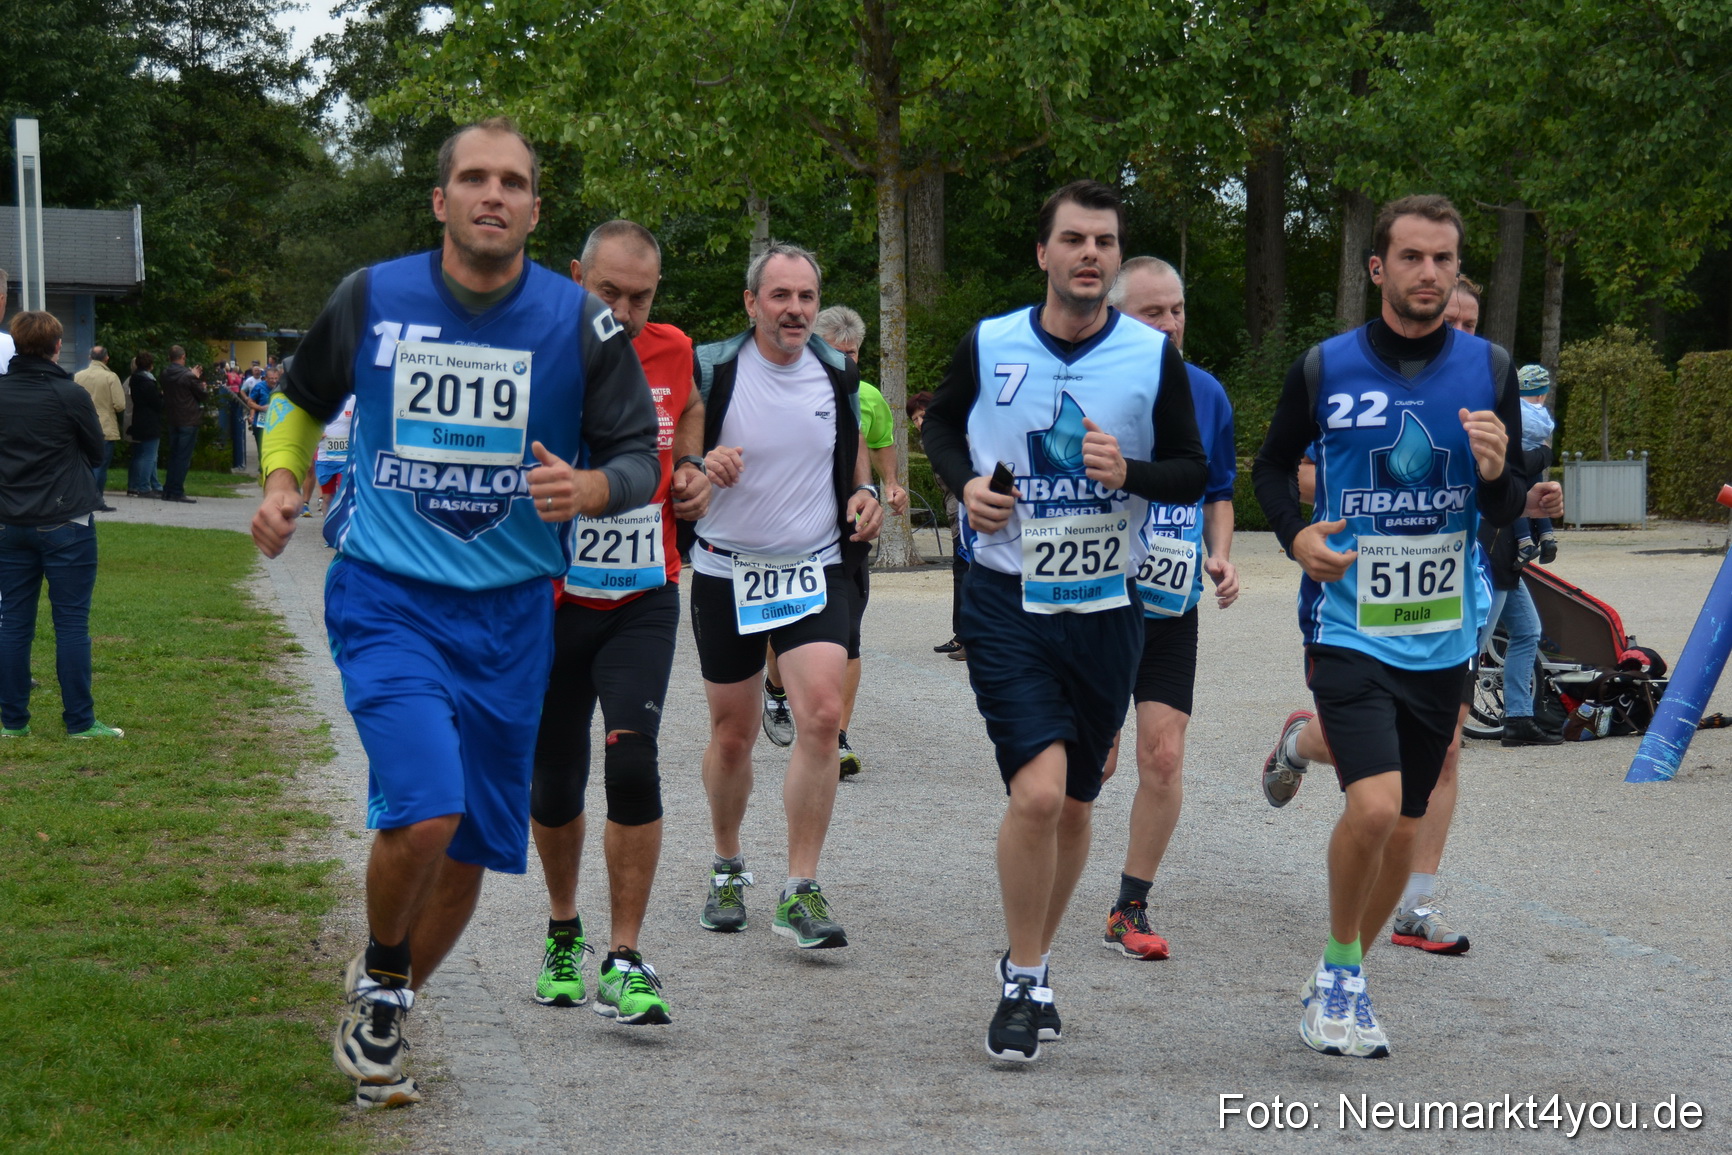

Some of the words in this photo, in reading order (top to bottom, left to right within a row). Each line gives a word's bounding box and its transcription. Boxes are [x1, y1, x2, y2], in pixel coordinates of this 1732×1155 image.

[400, 353, 443, 366] PARTL
[446, 356, 508, 372] Neumarkt
[995, 363, 1029, 406] 7
[408, 371, 518, 421] 2019
[1327, 391, 1389, 429] 22
[432, 427, 486, 448] Simon
[429, 498, 499, 514] BASKETS
[1343, 488, 1470, 514] FIBALON
[578, 514, 608, 524] ARTL
[610, 515, 653, 524] Neumarkt
[1045, 506, 1101, 517] BASKETS
[1385, 515, 1438, 527] BASKETS
[1024, 527, 1061, 537] PARTL
[1064, 523, 1114, 535] Neumarkt
[579, 527, 655, 563] 2211
[1150, 543, 1184, 557] Neumarkt
[1361, 546, 1398, 556] PARTL
[1401, 544, 1450, 556] Neumarkt
[1035, 537, 1120, 576] 2252
[601, 573, 637, 587] Josef
[1135, 554, 1188, 590] 620
[1370, 558, 1456, 598] 5162
[743, 566, 817, 601] 2076
[1053, 585, 1102, 601] Bastian
[1137, 589, 1166, 605] ther
[761, 603, 808, 620] Günther
[1394, 606, 1431, 622] Paula
